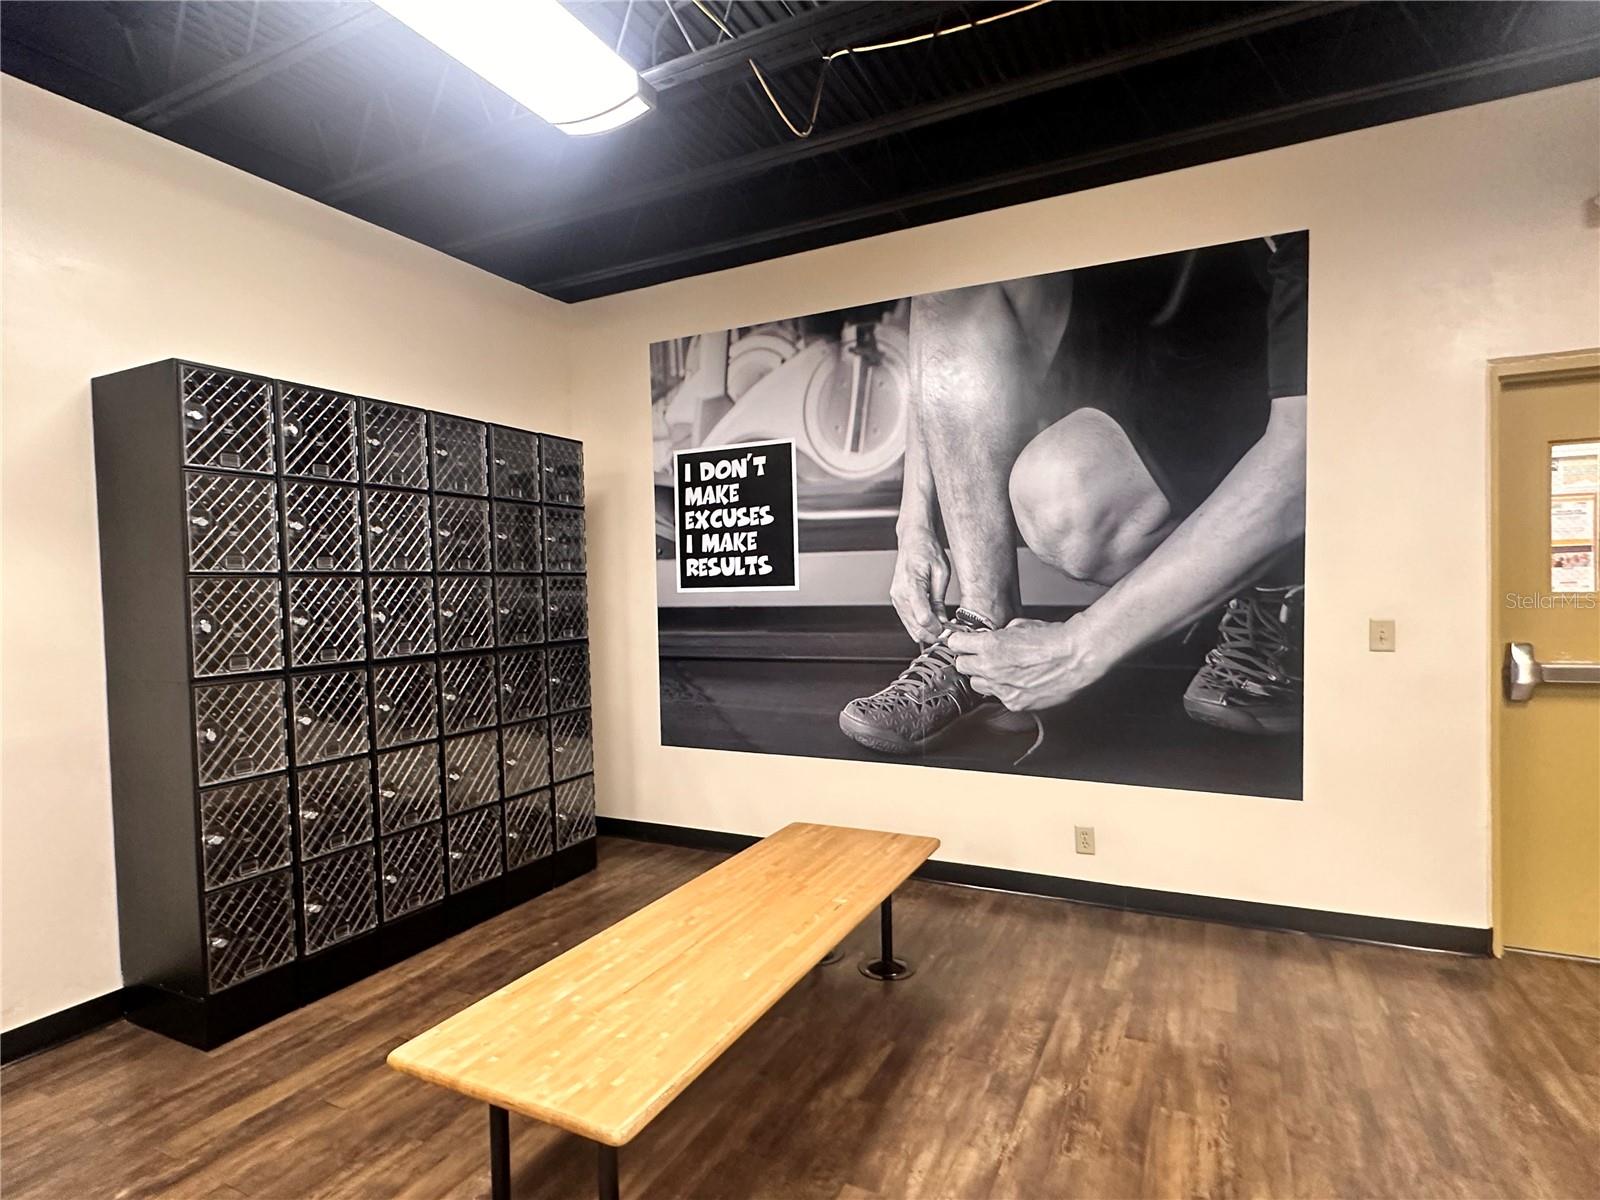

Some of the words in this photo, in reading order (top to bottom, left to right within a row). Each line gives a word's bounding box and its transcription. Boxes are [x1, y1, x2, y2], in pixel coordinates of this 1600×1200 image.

[685, 463, 691, 482] I
[700, 453, 767, 481] DON'T
[685, 483, 740, 506] MAKE
[685, 505, 775, 530] EXCUSES
[686, 534, 693, 553] I
[701, 531, 758, 553] MAKE
[686, 555, 773, 577] RESULTS
